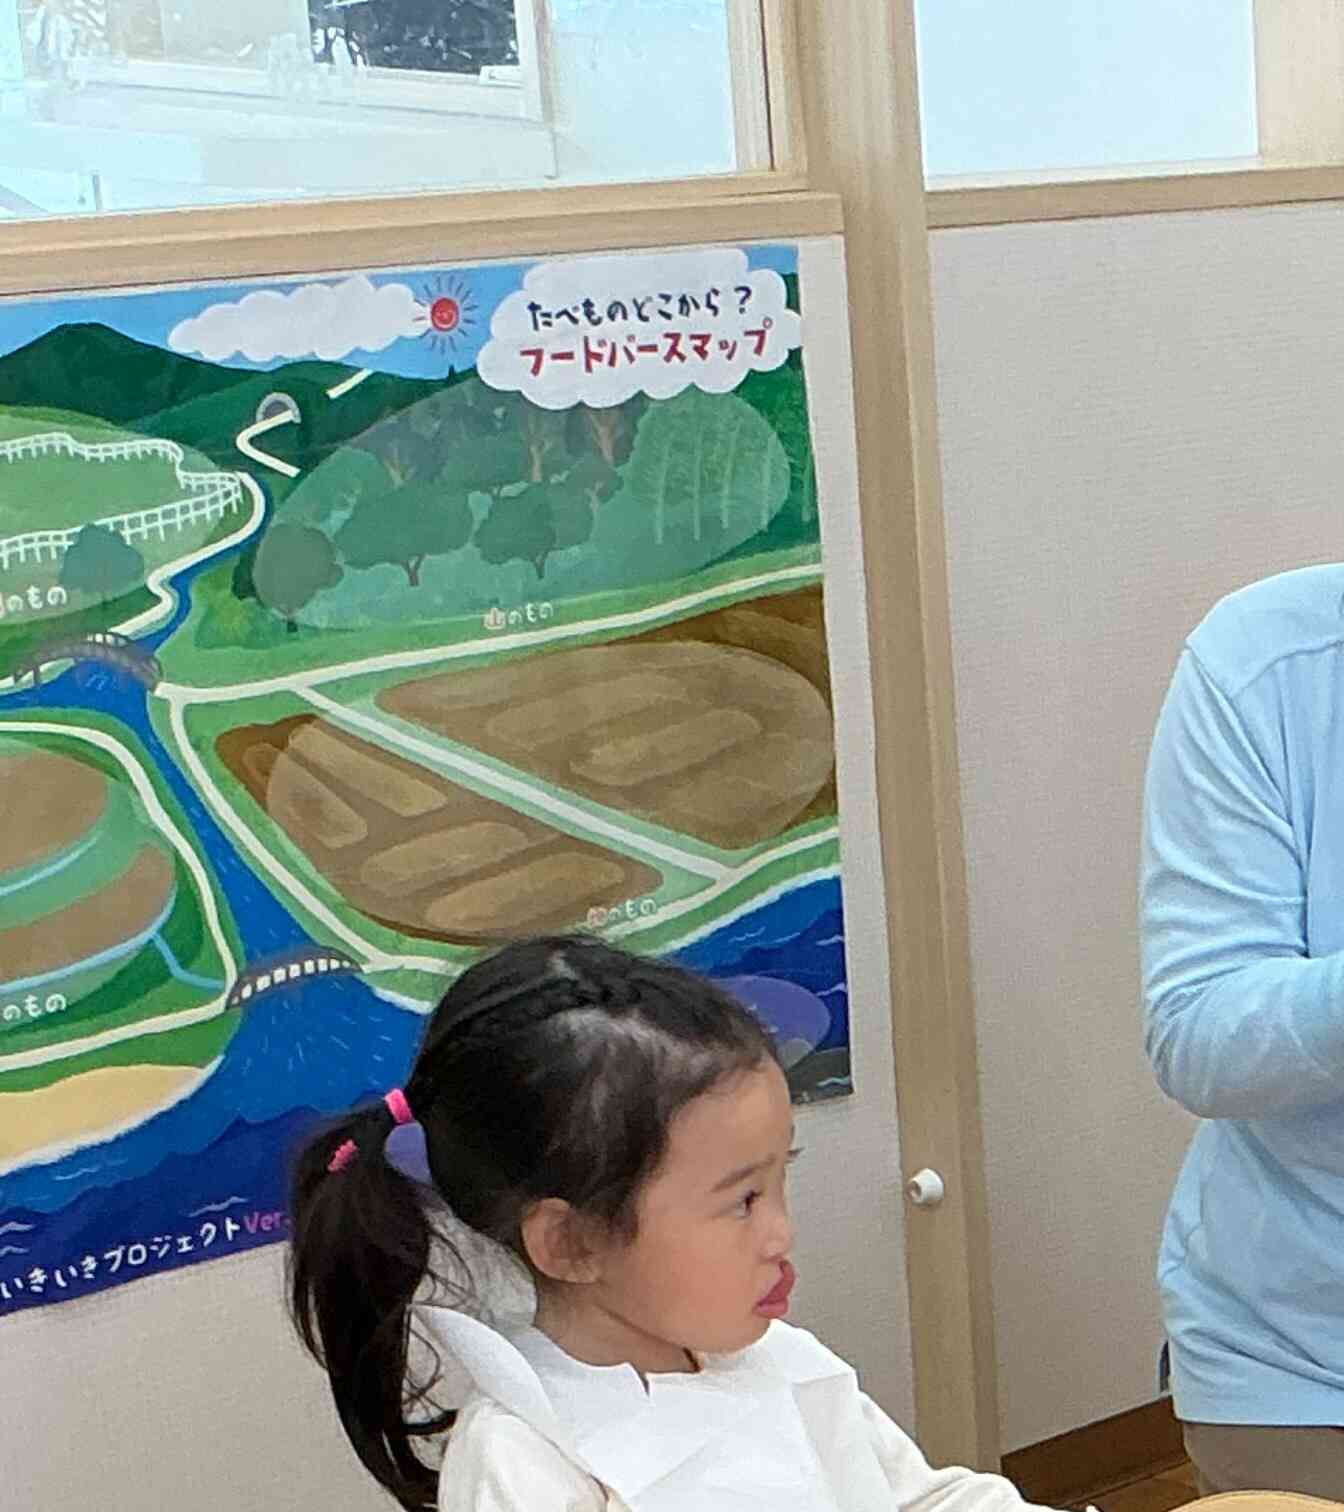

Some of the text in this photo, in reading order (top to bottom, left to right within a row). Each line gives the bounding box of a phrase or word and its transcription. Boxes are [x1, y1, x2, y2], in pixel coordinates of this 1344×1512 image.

[520, 316, 773, 376] フードバースマップ
